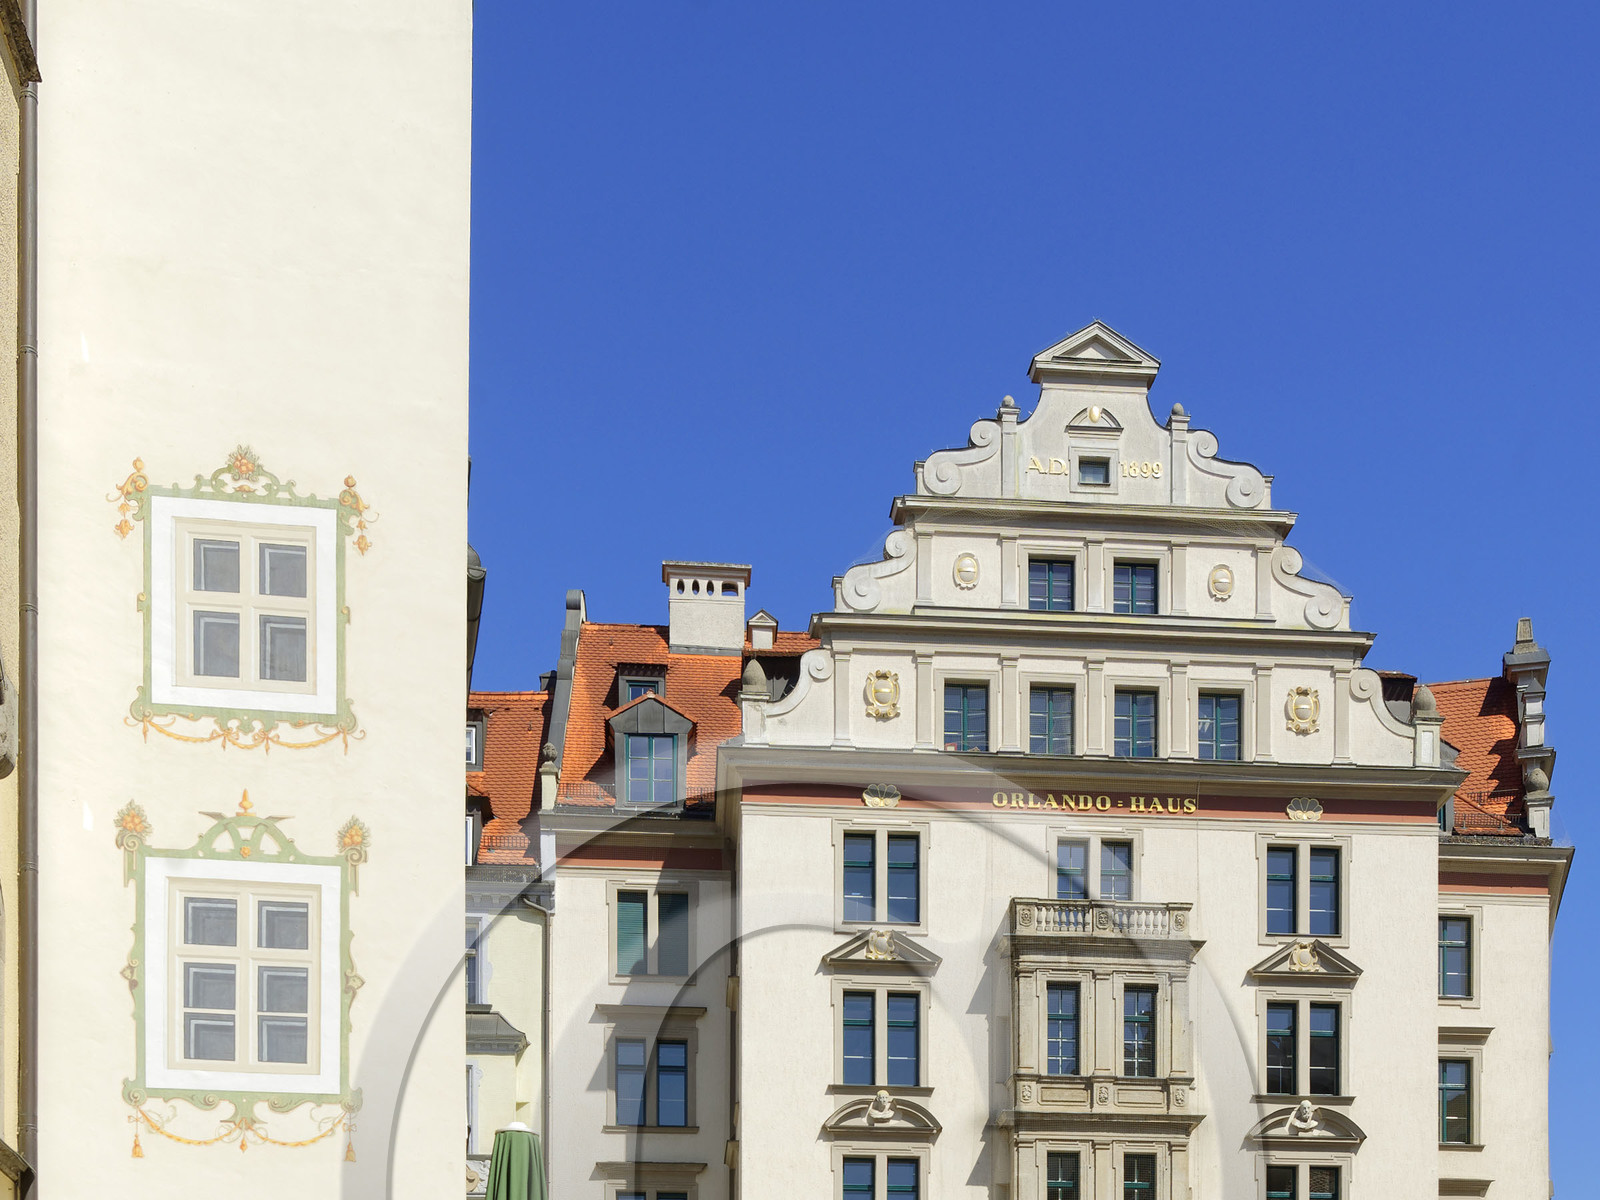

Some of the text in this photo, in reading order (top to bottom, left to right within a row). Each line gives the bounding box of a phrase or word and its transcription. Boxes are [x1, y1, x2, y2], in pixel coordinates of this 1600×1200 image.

[1120, 460, 1164, 479] 1899
[992, 791, 1112, 811] ORLANDO
[1129, 796, 1197, 814] HAUS
